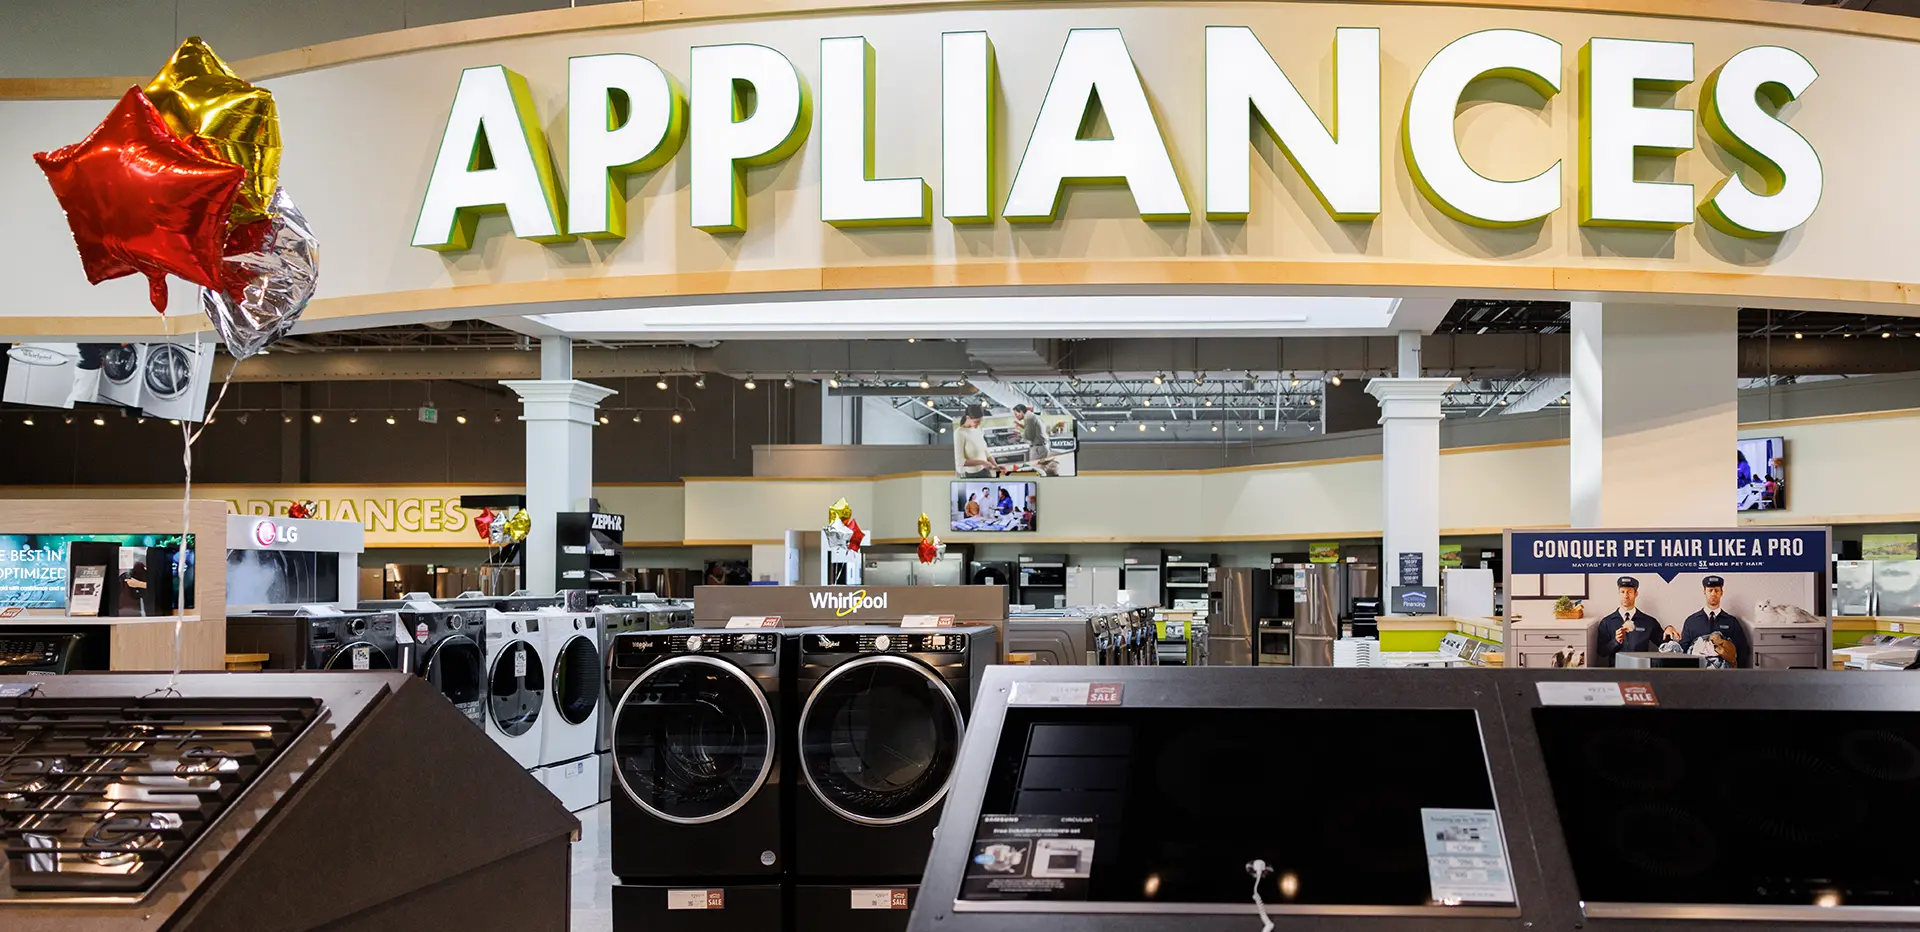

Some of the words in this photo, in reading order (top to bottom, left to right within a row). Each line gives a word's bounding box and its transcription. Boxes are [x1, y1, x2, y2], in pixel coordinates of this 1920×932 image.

[411, 26, 1824, 252] APPLIANCES
[278, 526, 298, 543] LG
[1533, 539, 1617, 560] CONQUER
[1623, 540, 1655, 558] PET
[1661, 539, 1702, 557] HAIR
[1708, 538, 1746, 557] LIKE
[1751, 538, 1762, 556] A
[1768, 537, 1803, 556] PRO
[10, 550, 42, 561] BEST
[47, 550, 62, 561] IN
[1698, 560, 1708, 568] 5X
[809, 591, 888, 614] Whirlpool
[1090, 692, 1117, 701] SALE
[1625, 692, 1653, 701] SALE
[708, 898, 722, 906] SALE
[892, 898, 907, 906] SALE
